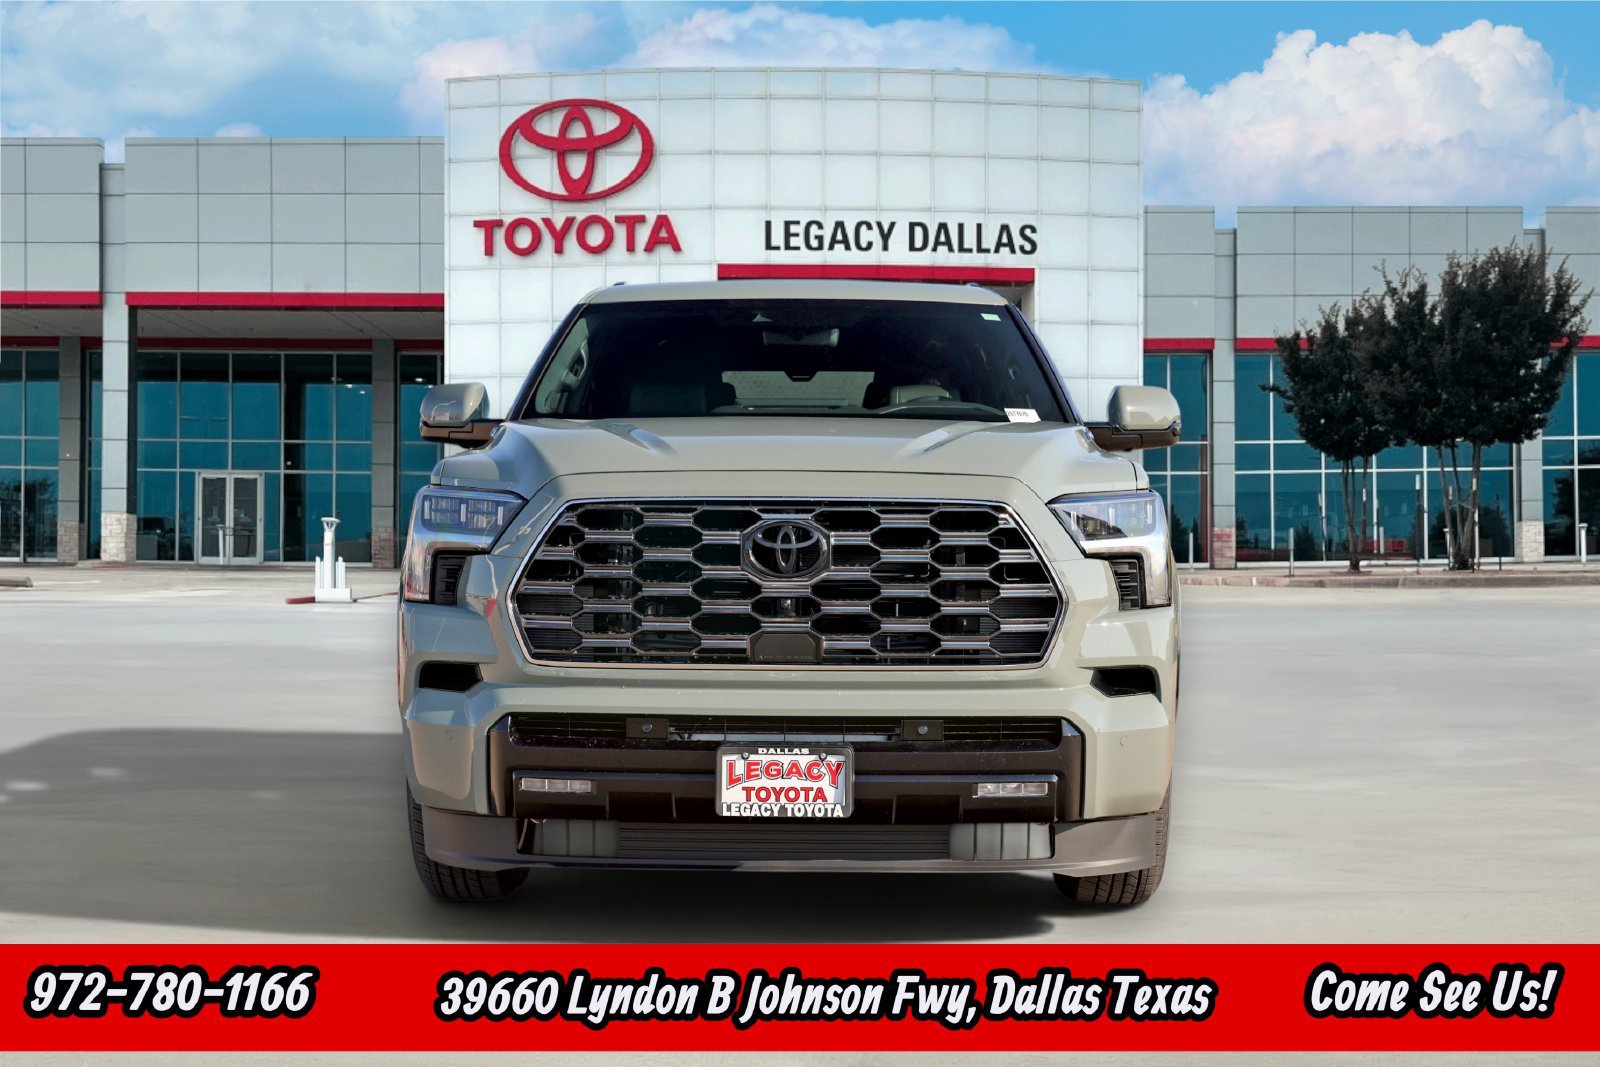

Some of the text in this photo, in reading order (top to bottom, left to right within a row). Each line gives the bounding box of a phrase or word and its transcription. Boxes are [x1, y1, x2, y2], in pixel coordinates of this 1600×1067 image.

[474, 214, 682, 257] TOYOTA
[764, 220, 1038, 256] LEGACY DALLAS
[757, 747, 811, 755] DALLAS
[726, 759, 845, 790] LEGACY
[742, 786, 828, 803] TOYOTA
[721, 802, 844, 818] LEGACY TOYOTA
